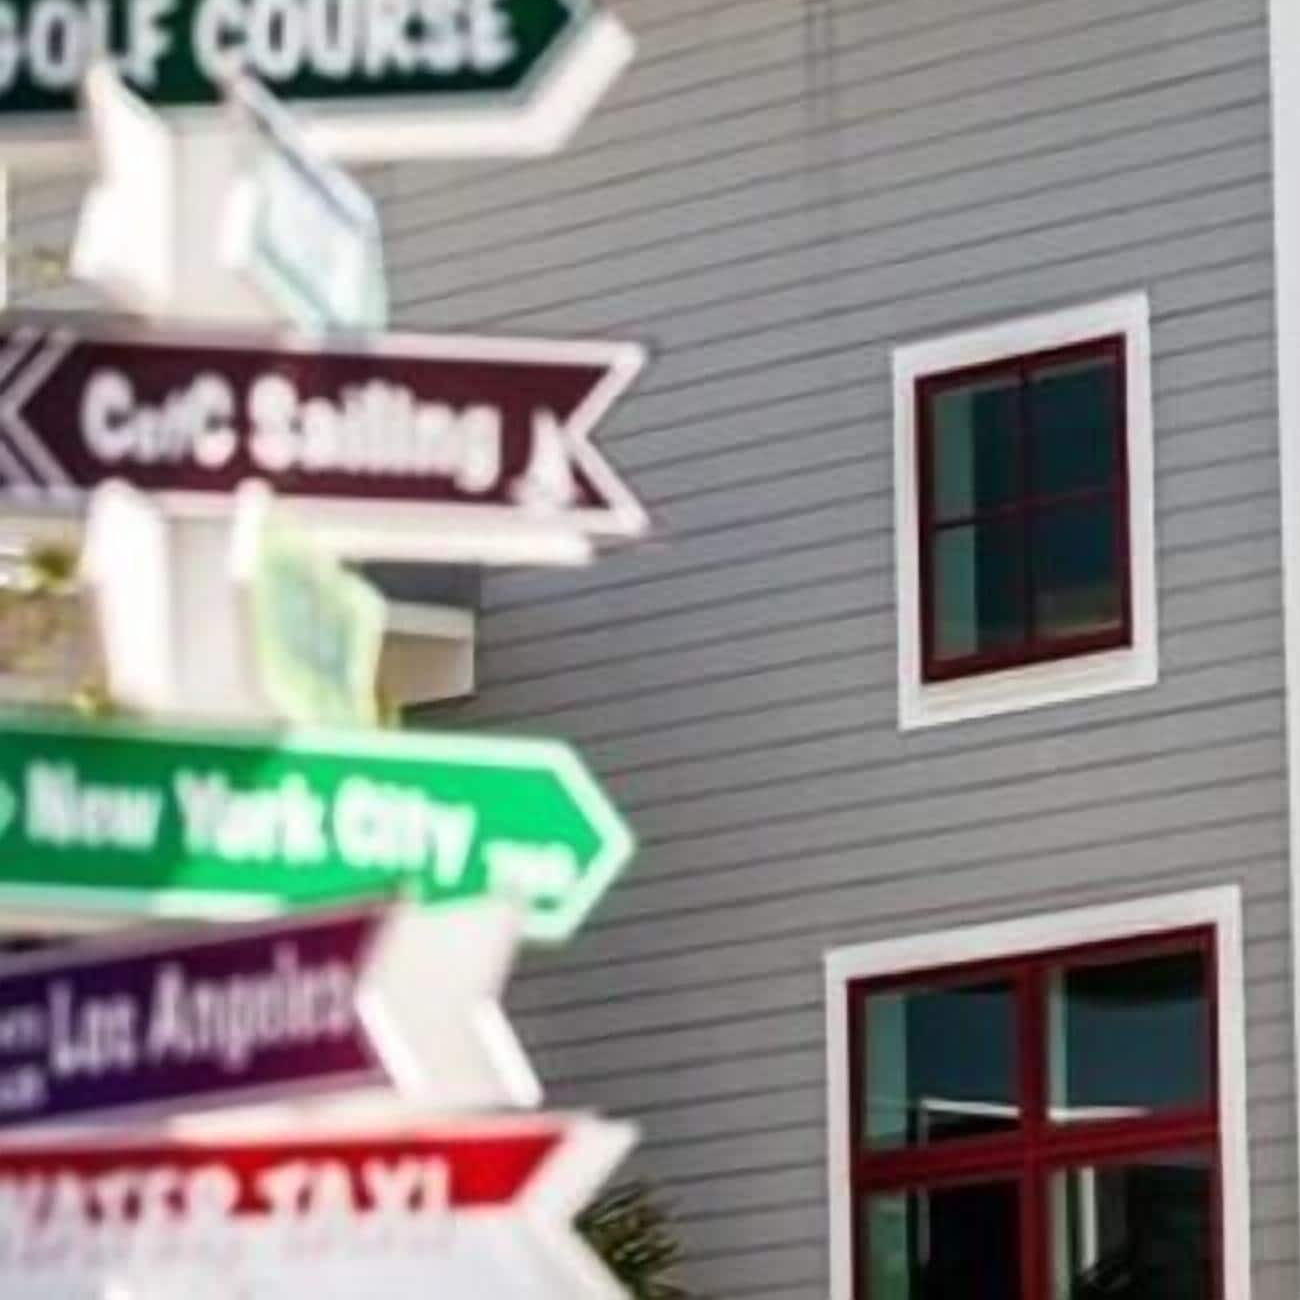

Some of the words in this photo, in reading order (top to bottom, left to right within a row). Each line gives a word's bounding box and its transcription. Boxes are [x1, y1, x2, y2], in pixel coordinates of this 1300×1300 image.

[248, 372, 501, 494] Sailing
[24, 760, 163, 851] New
[174, 764, 328, 864] York
[332, 775, 477, 888] City
[51, 982, 137, 1075] Los
[146, 942, 354, 1074] Angeles
